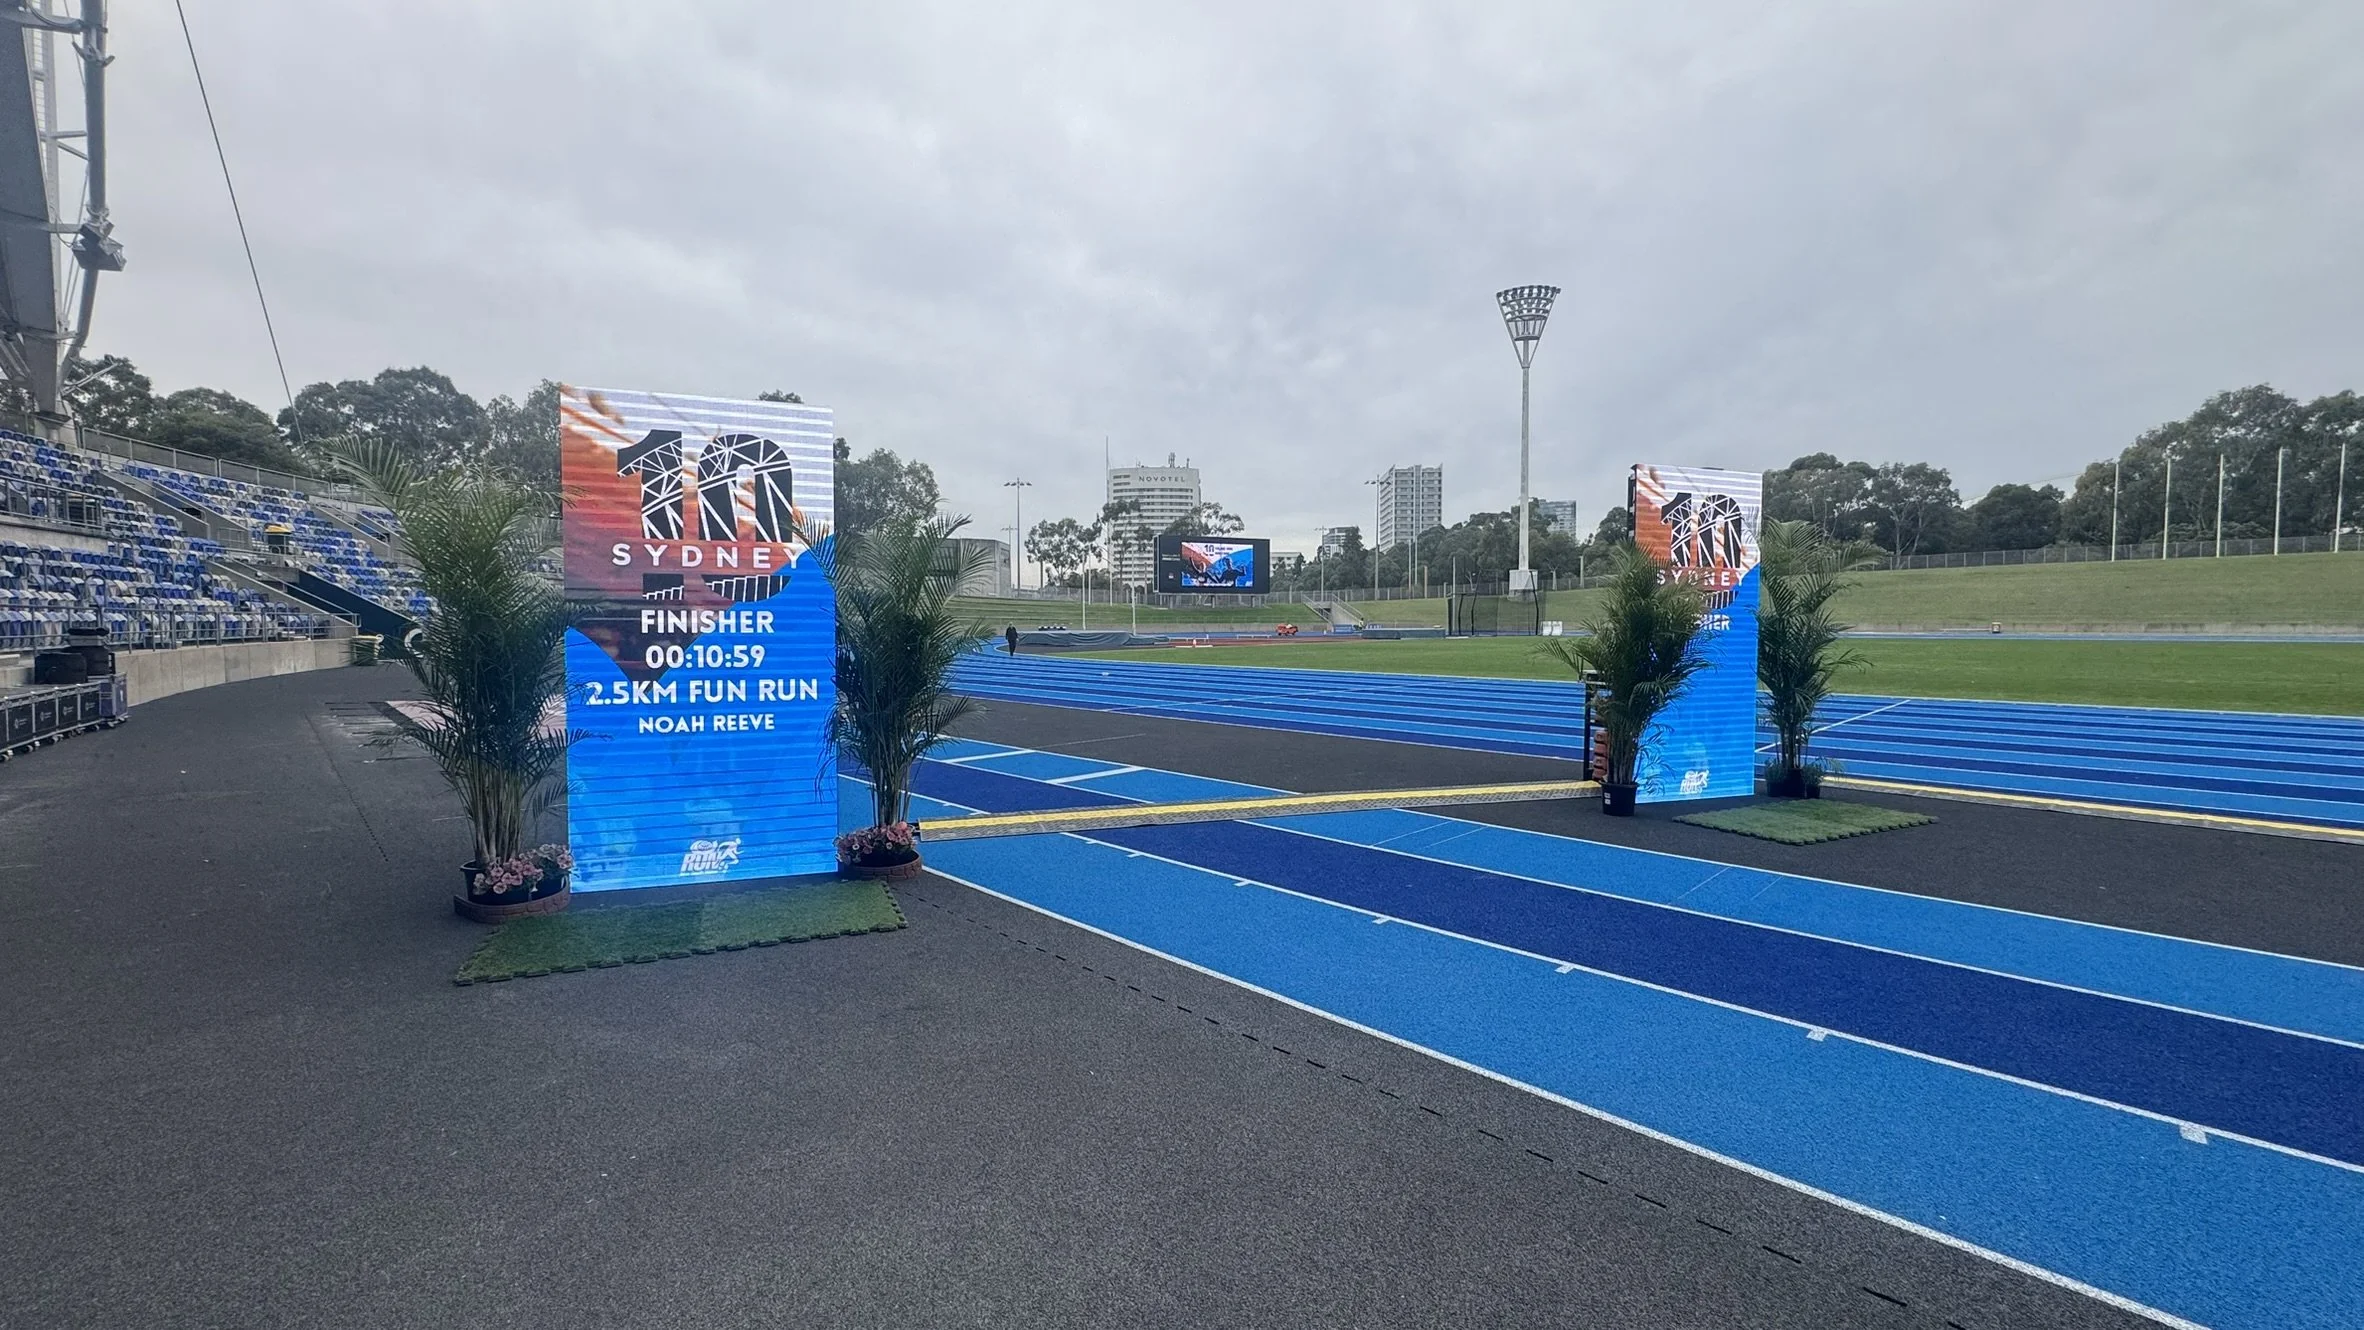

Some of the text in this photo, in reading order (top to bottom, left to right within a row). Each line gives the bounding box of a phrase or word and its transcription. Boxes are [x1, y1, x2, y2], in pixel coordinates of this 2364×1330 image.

[1138, 475, 1186, 483] NOVOTEL
[617, 429, 793, 602] 10
[612, 543, 801, 569] SYDNEY
[641, 609, 774, 634] FINISHER
[645, 644, 765, 669] 00:10:59
[586, 678, 818, 705] 2.5KM FUN RUN
[639, 713, 775, 734] NOAH REEVE
